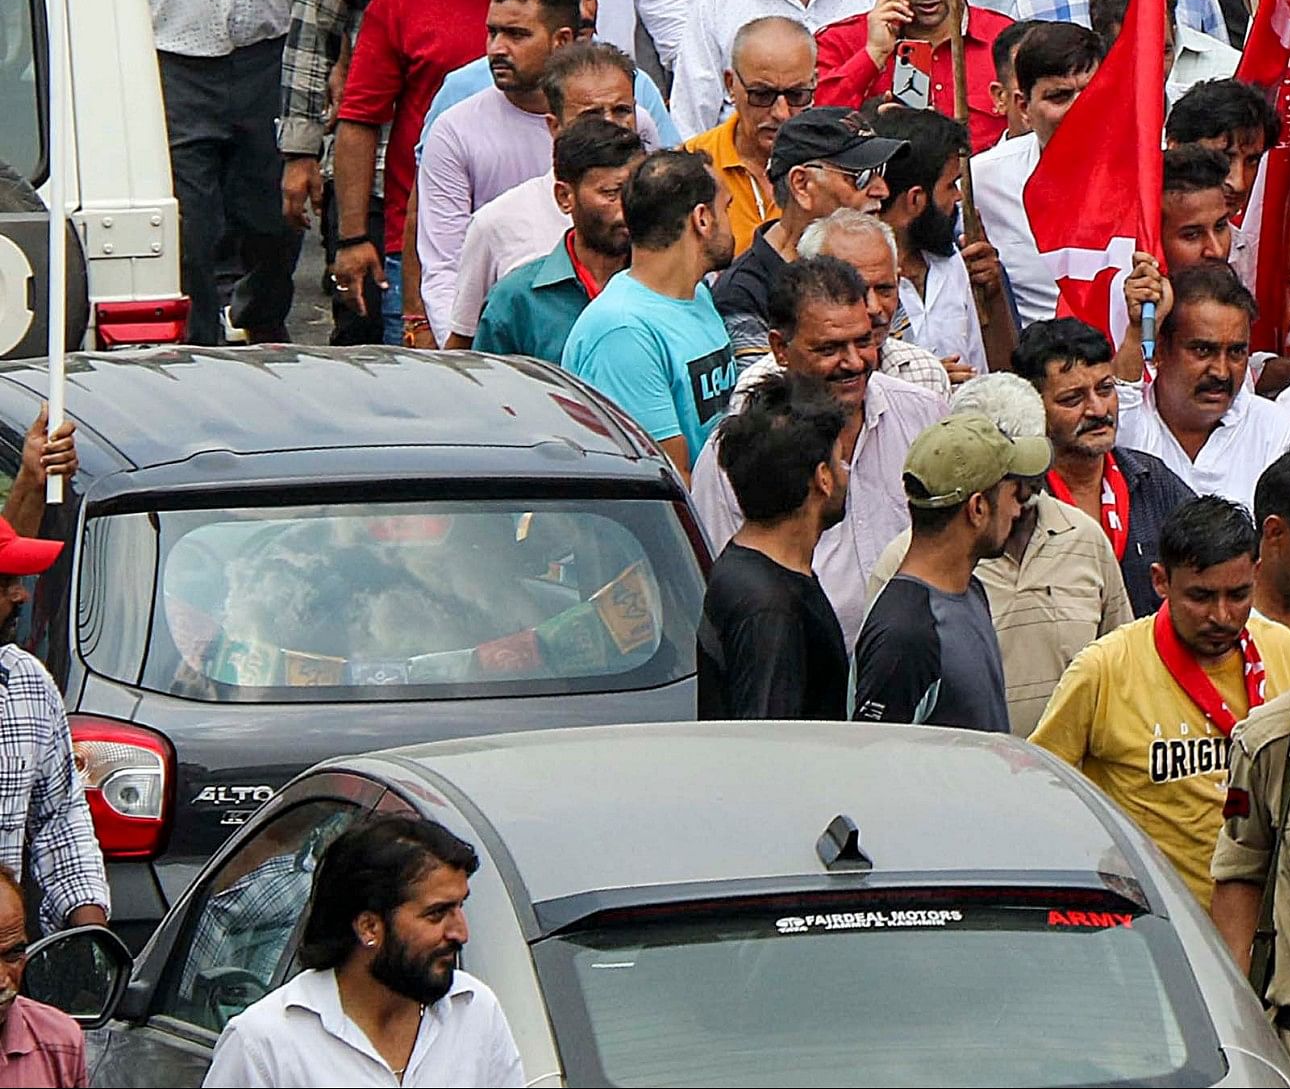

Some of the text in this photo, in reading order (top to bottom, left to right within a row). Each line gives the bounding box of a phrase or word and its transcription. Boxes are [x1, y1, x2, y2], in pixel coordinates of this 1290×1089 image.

[191, 785, 274, 805] ALTO
[805, 910, 963, 926] FAIRDEAL MOTORS
[1048, 910, 1134, 929] ARMY
